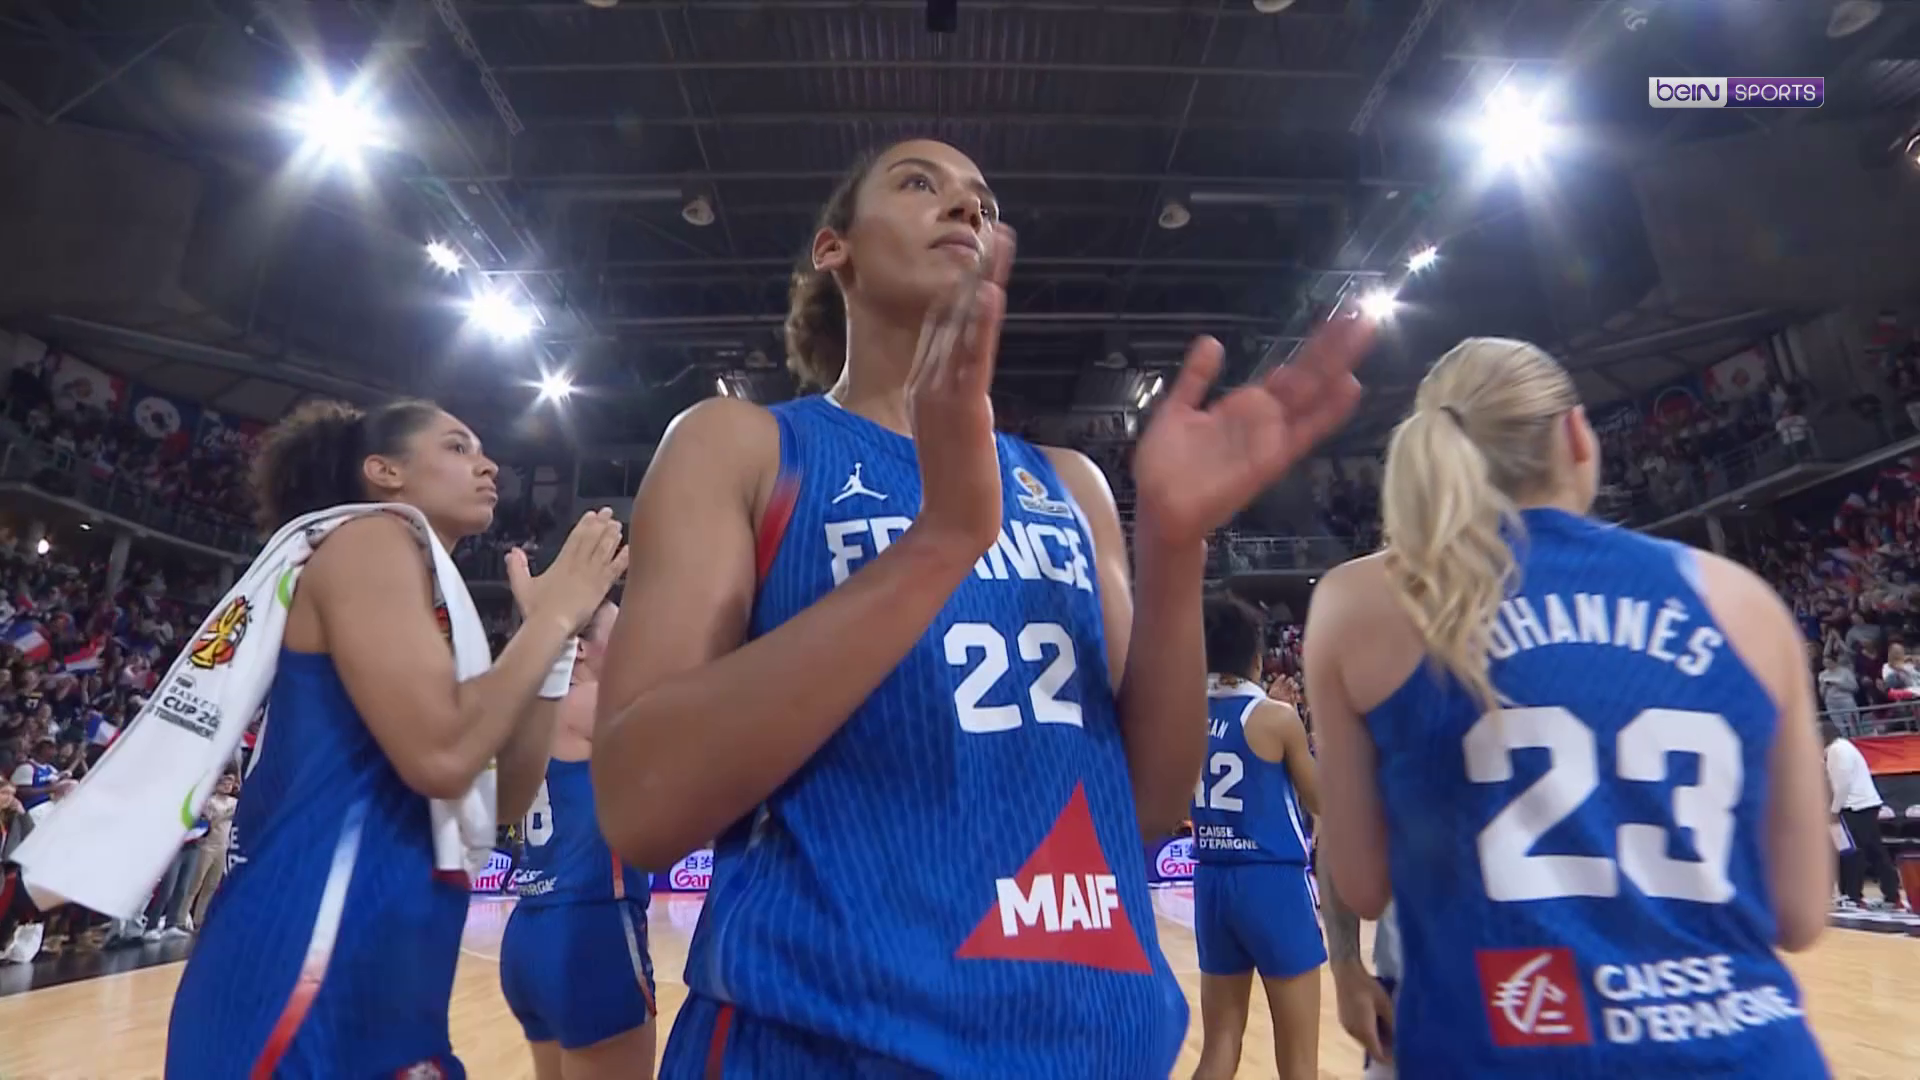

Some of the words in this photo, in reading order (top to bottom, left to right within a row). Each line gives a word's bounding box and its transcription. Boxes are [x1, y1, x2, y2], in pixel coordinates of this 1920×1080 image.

[1485, 592, 1724, 677] OHANNÈS
[163, 696, 197, 716] CUP
[943, 622, 1083, 733] 22
[1199, 826, 1235, 838] CAISSE
[1462, 706, 1744, 904] 23
[995, 873, 1119, 937] MAIF
